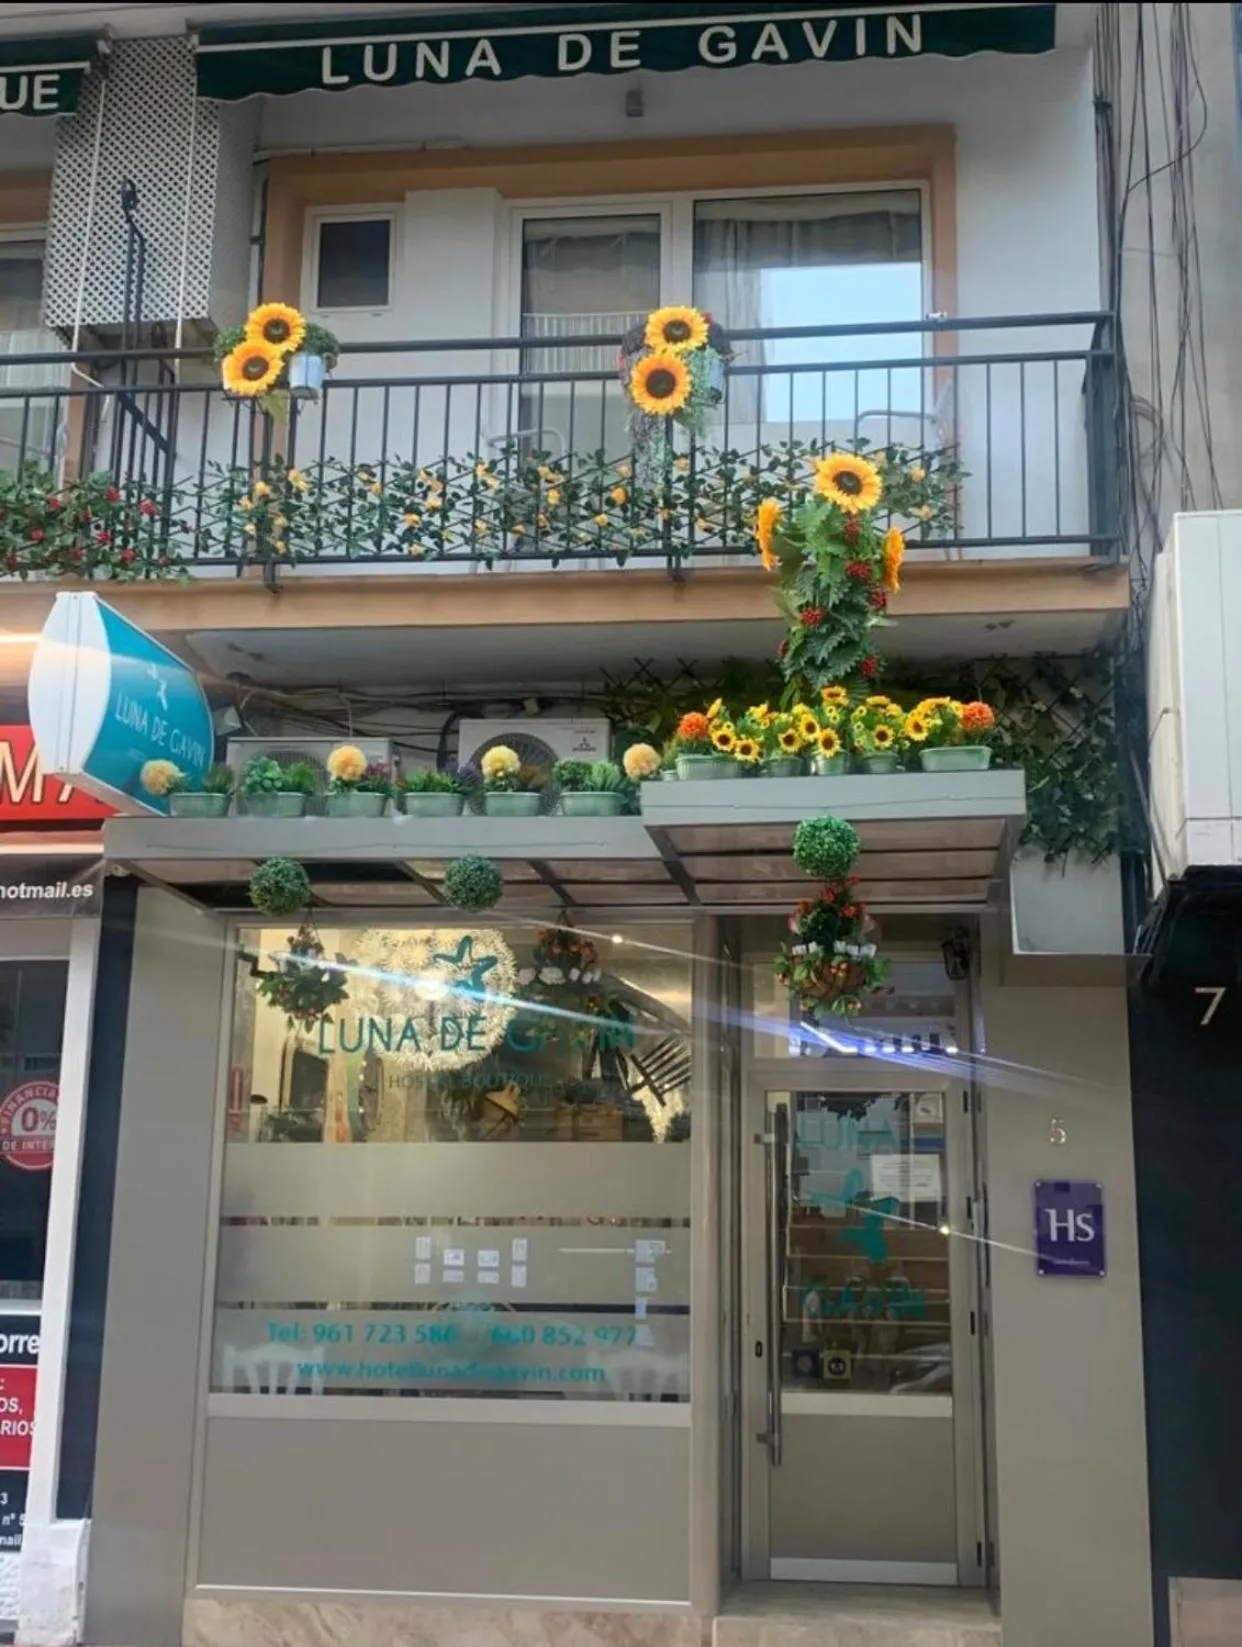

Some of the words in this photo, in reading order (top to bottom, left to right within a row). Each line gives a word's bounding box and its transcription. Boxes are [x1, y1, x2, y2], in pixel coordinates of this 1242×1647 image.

[322, 38, 502, 85] LUNA
[557, 30, 642, 72] DE
[699, 14, 923, 64] GAVIN
[0, 73, 61, 110] UE
[115, 693, 148, 736] LUNA
[151, 715, 169, 747] DE
[0, 741, 75, 804] M
[1195, 986, 1227, 1025] 7
[317, 1016, 420, 1054] LUNA
[441, 1016, 487, 1051] DE
[21, 1107, 57, 1132] 0%
[1050, 1117, 1068, 1145] 5
[268, 1321, 304, 1343] Tel:
[313, 1323, 354, 1343] 961
[364, 1323, 407, 1344] 723
[541, 1326, 587, 1347] 852
